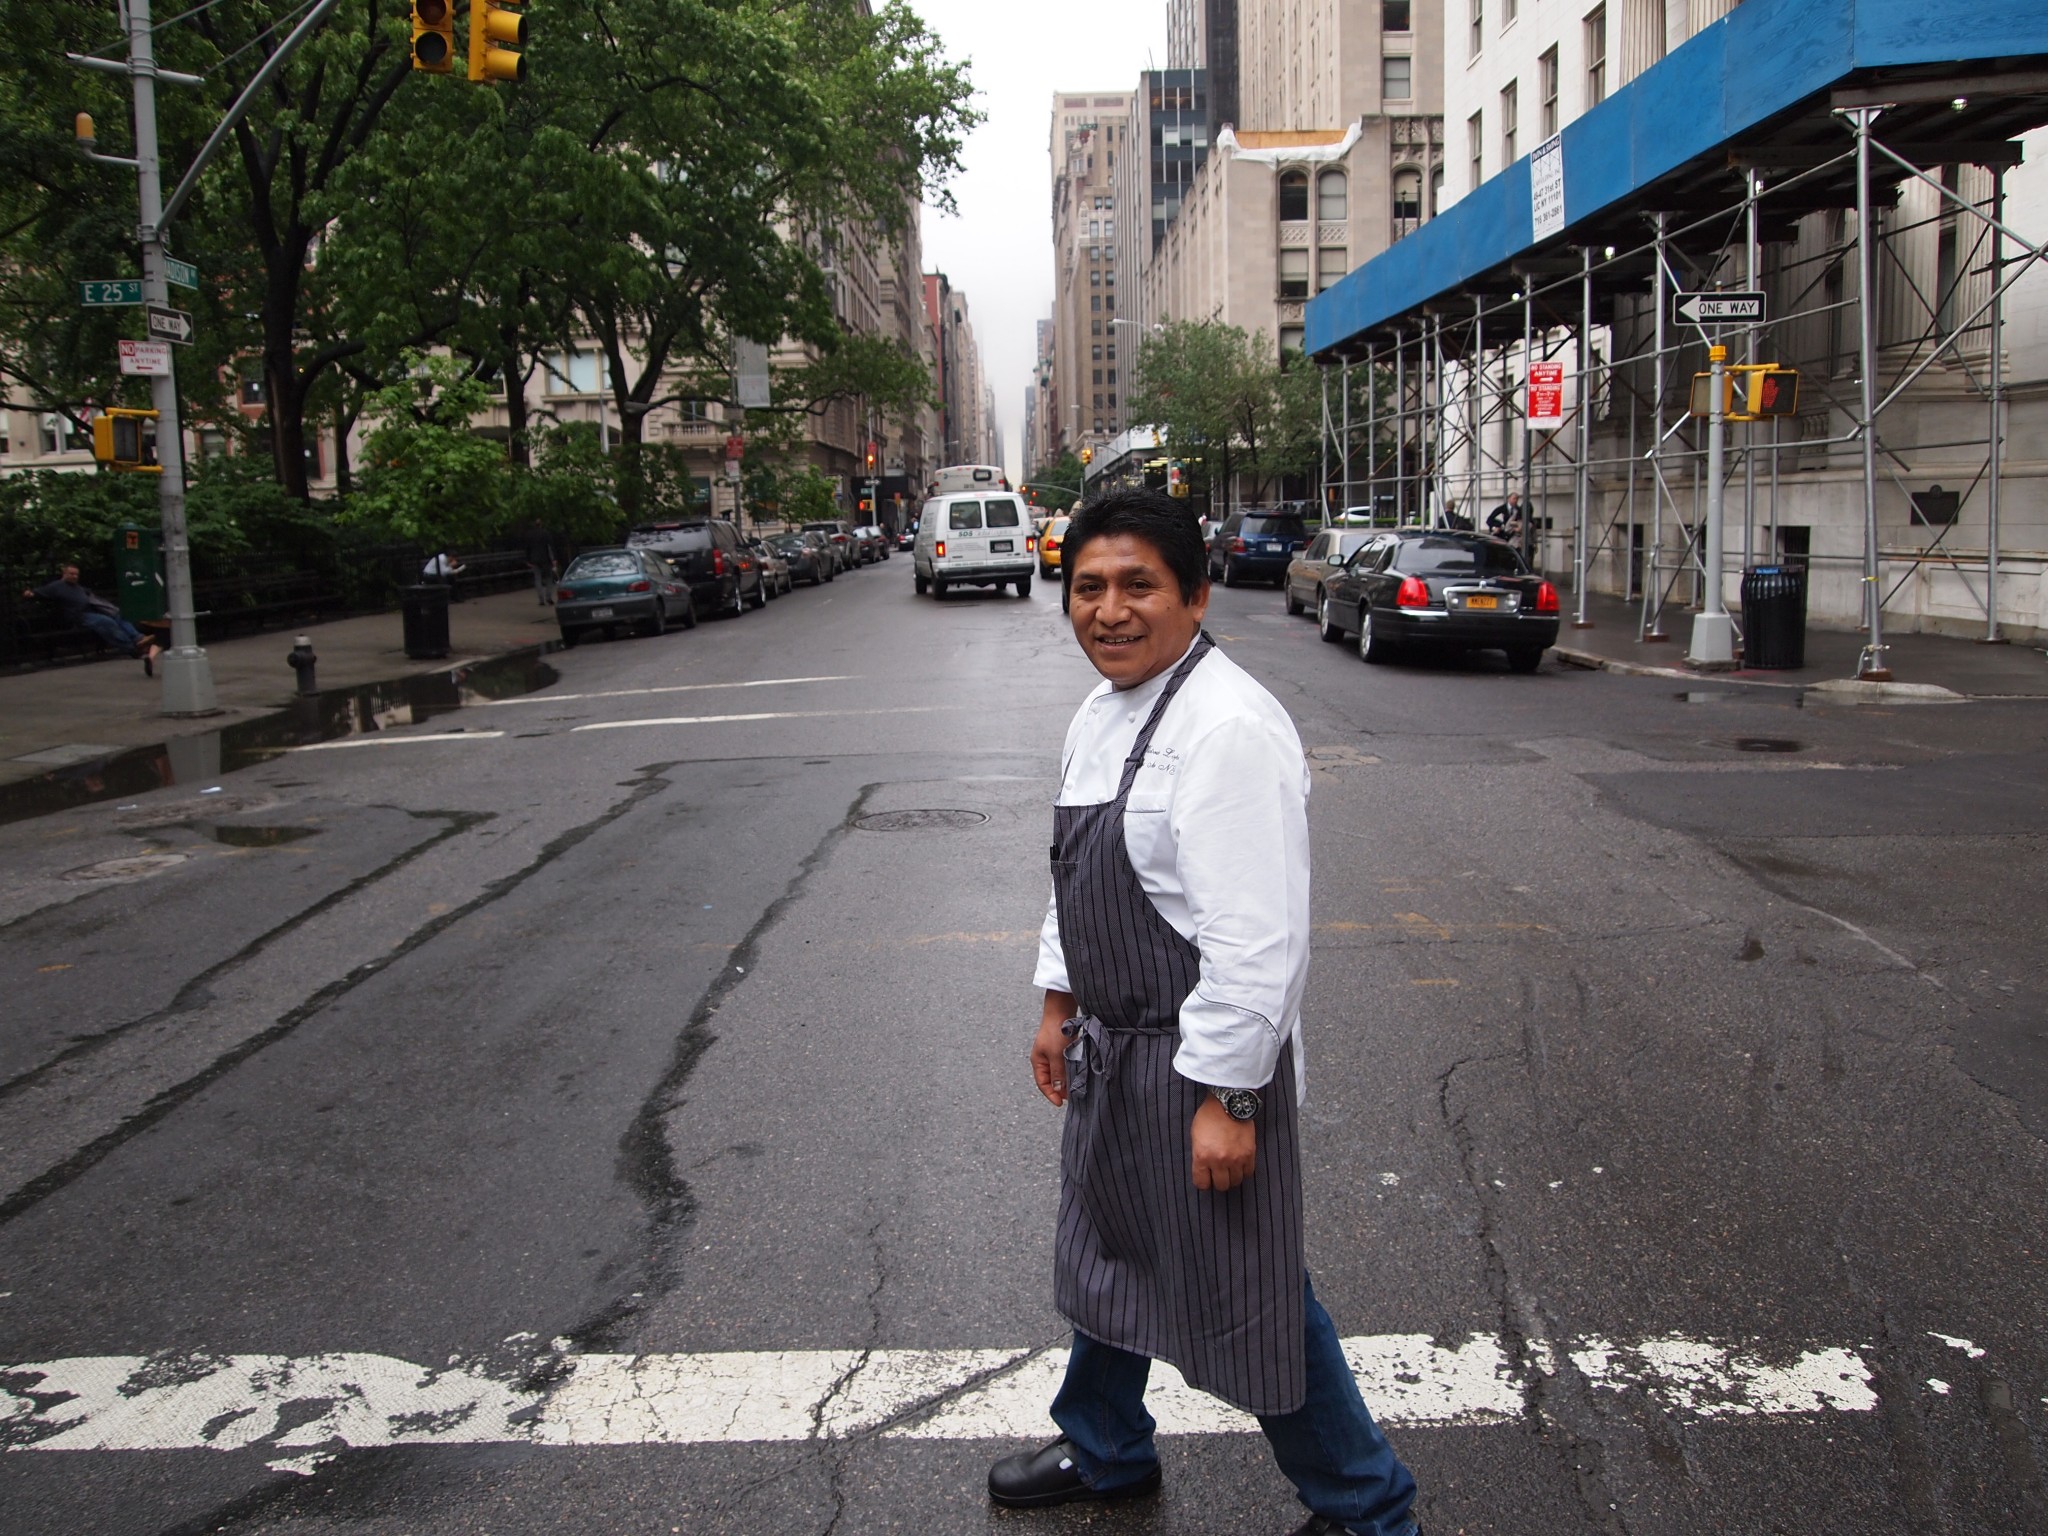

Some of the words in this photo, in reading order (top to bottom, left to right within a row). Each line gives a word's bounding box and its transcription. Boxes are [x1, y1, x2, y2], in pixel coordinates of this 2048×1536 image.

[85, 284, 95, 302] E
[102, 284, 123, 302] 25
[129, 283, 138, 293] ST
[1699, 303, 1723, 314] ONE
[1730, 302, 1755, 313] WAY
[152, 315, 166, 330] ONE
[168, 317, 181, 332] WAY
[121, 343, 134, 355] NO
[135, 346, 166, 355] PARKING
[130, 357, 162, 365] ANYTIME
